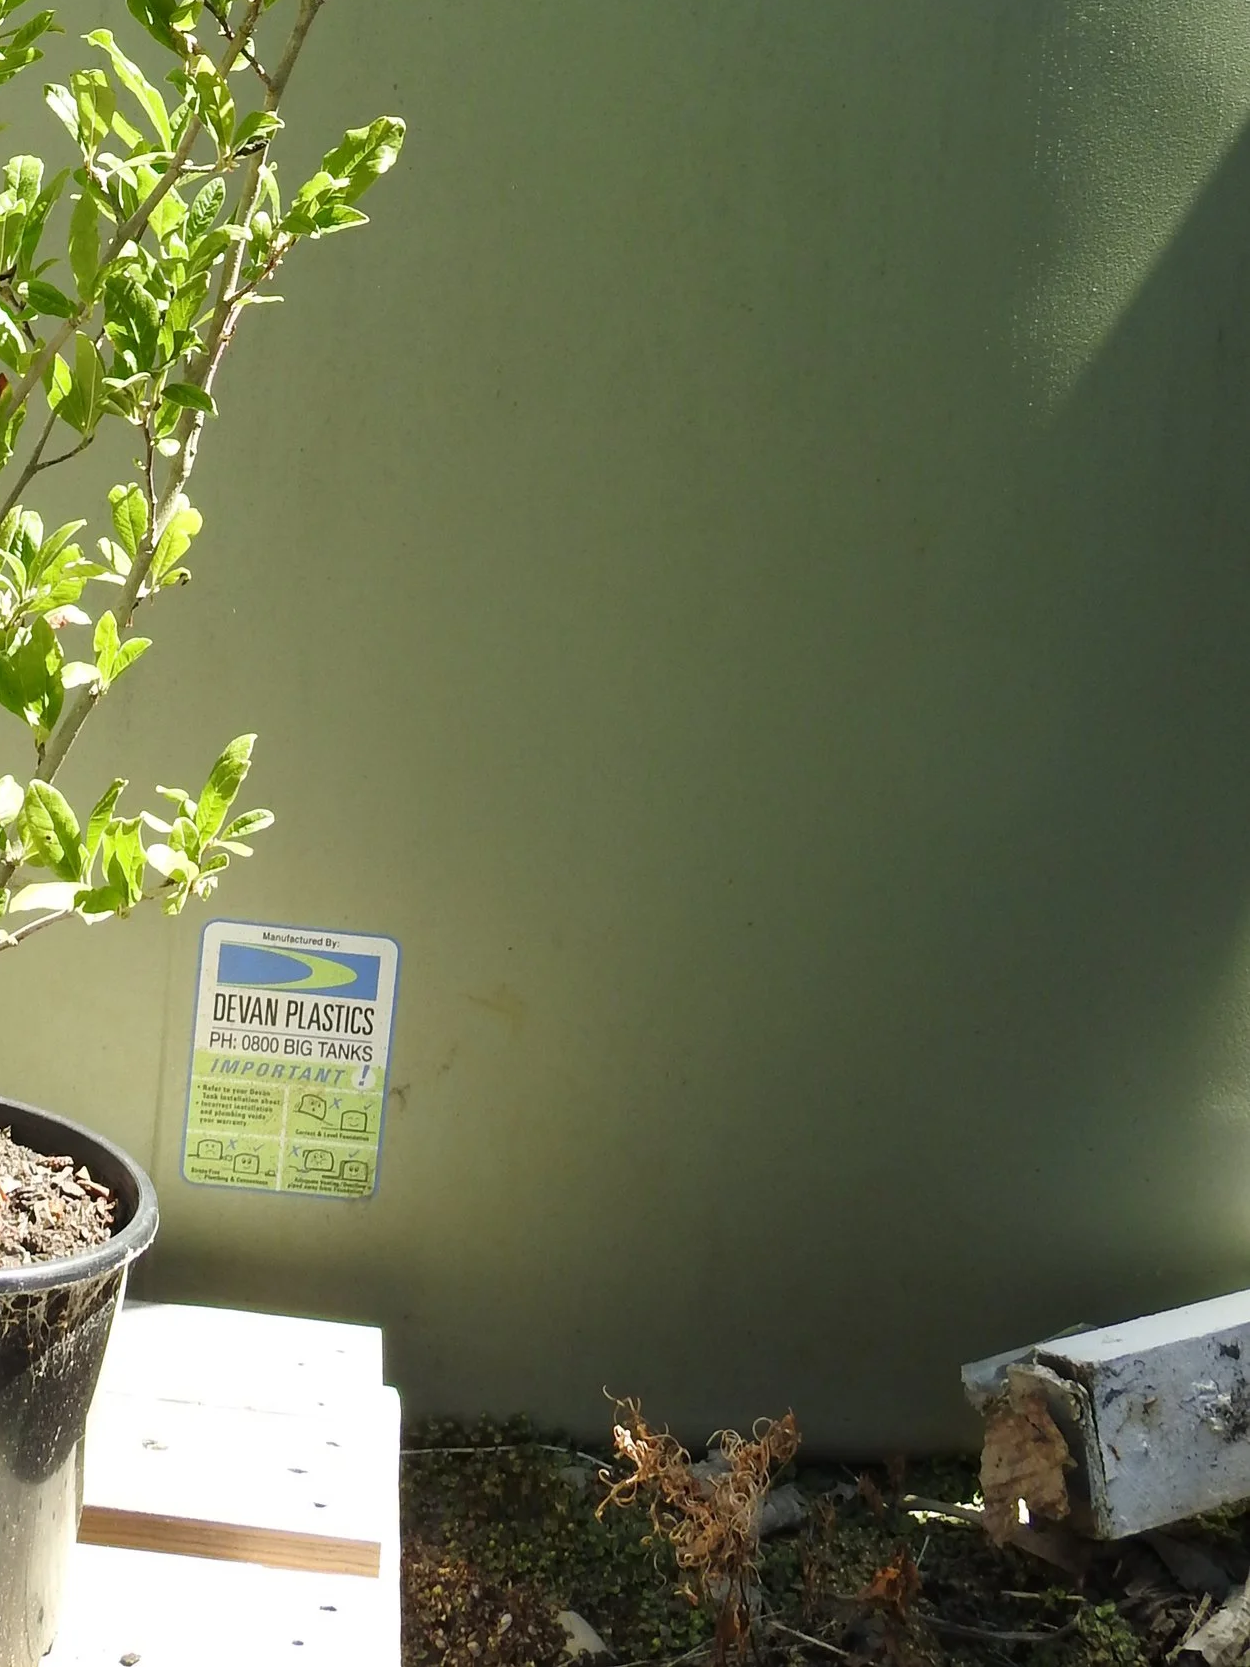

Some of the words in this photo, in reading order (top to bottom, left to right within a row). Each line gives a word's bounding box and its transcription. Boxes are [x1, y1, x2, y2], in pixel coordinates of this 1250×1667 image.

[263, 932, 323, 947] Manufactured
[325, 938, 340, 949] By:
[213, 993, 279, 1027] DEVAN
[285, 999, 375, 1036] PLASTICS
[209, 1032, 237, 1050] PH:
[242, 1034, 280, 1053] 0800
[284, 1038, 313, 1057] BIG
[318, 1041, 373, 1063] TANKS
[210, 1058, 346, 1084] IMPORTANT
